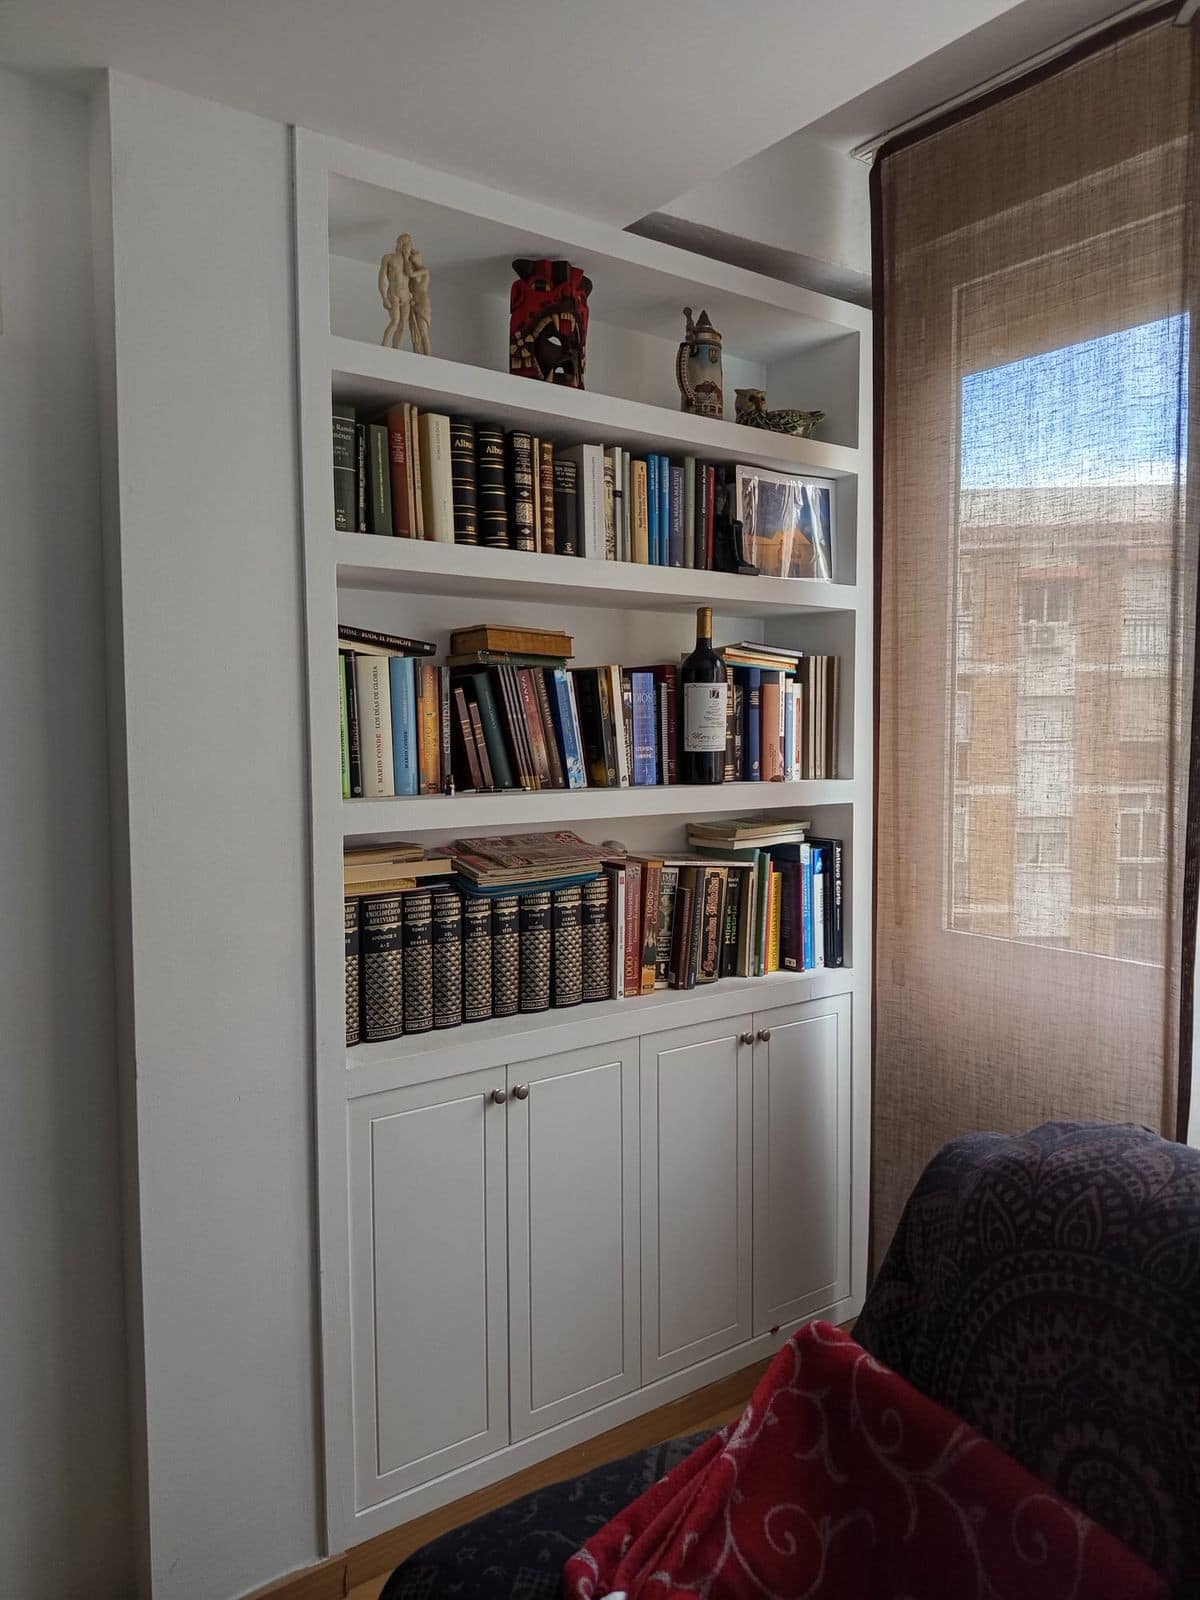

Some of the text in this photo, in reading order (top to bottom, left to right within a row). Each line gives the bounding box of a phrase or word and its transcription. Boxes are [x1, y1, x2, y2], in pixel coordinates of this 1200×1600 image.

[340, 627, 357, 636] VIDAL
[371, 665, 379, 690] GLORIA
[372, 690, 379, 700] DE
[372, 700, 380, 716] DÍAS
